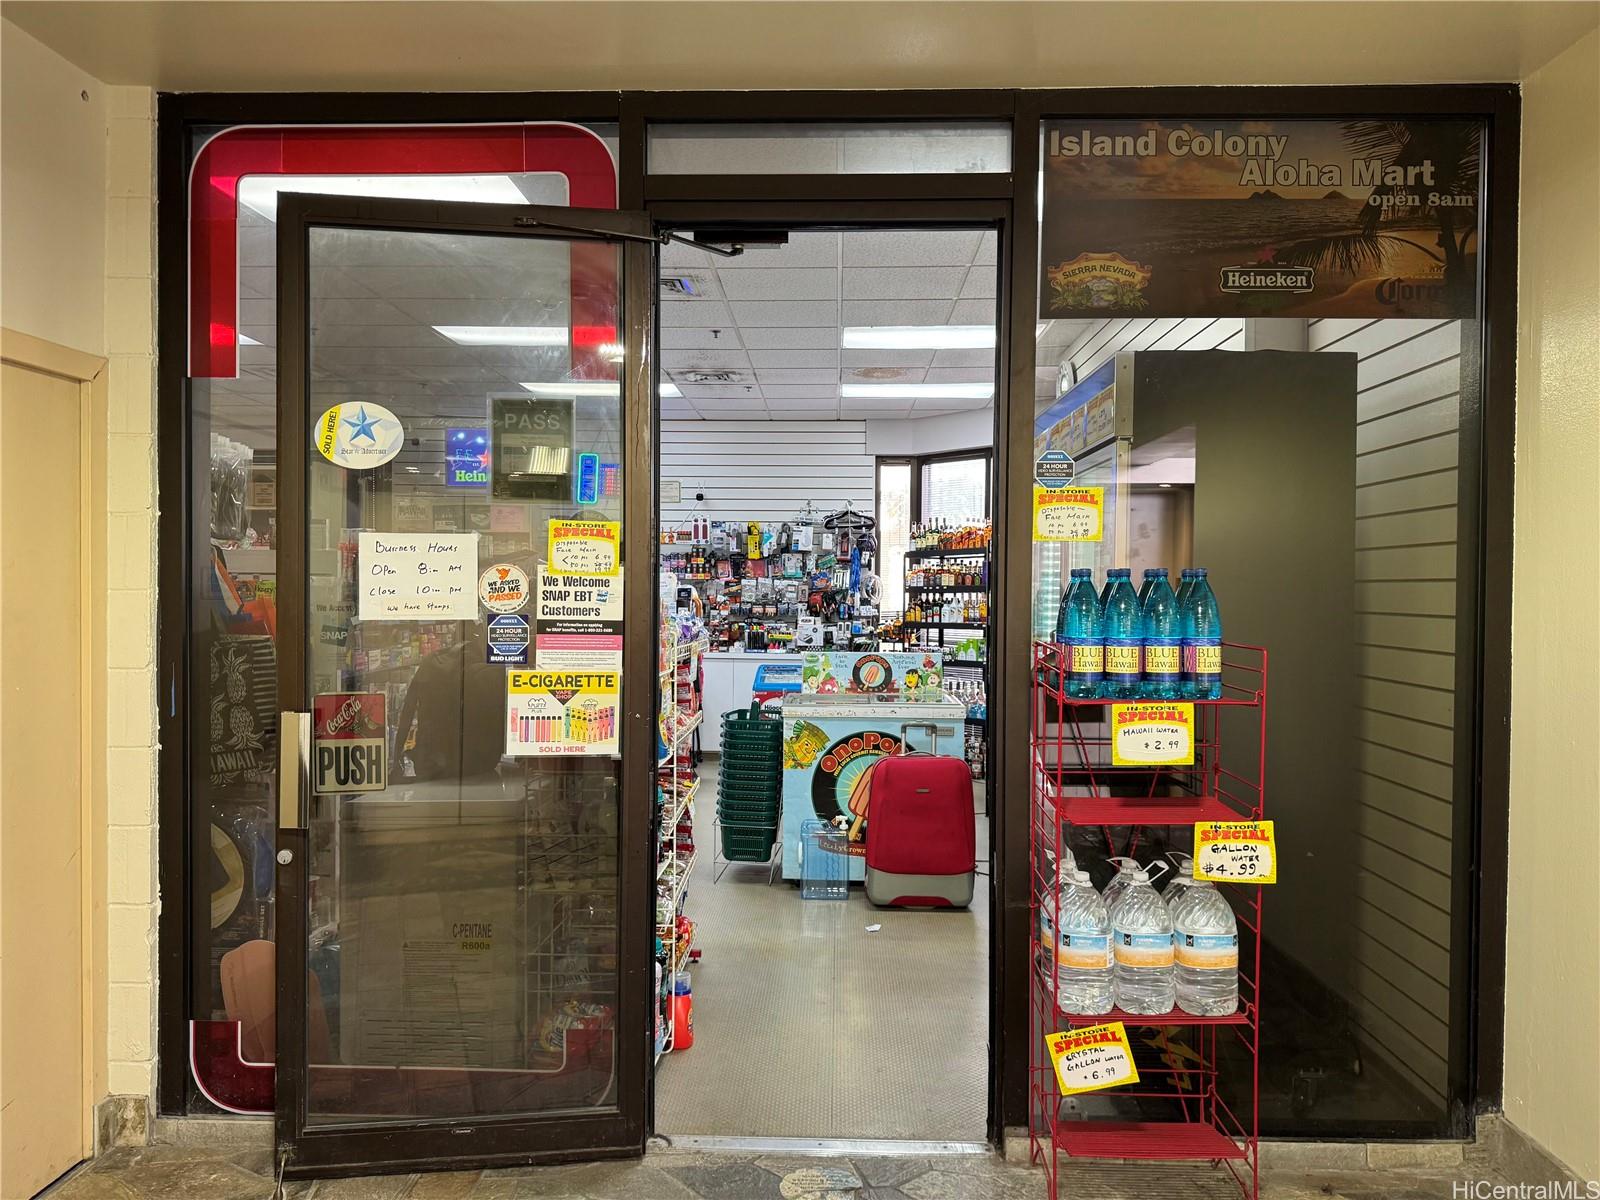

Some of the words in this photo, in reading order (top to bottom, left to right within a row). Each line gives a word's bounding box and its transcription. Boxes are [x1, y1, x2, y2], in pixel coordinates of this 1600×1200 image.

[1050, 129, 1156, 157] Island
[1168, 129, 1288, 161] Colony
[1238, 158, 1342, 187] Aloha
[1351, 159, 1436, 187] Mart
[1368, 193, 1423, 210] open
[1427, 191, 1475, 208] 8am
[1062, 264, 1098, 280] SIERRA
[1099, 264, 1137, 279] NEVADA
[1227, 271, 1308, 287] Heineken
[326, 410, 337, 434] HERE!
[504, 413, 561, 430] PASS
[322, 435, 333, 455] SOLD
[1038, 494, 1099, 505] SPECIAL
[553, 527, 615, 540] SPECIAL
[375, 541, 416, 553] Business
[427, 542, 458, 553] Hours
[542, 575, 559, 587] We
[562, 576, 611, 588] Welcome
[488, 586, 505, 594] AND
[508, 584, 520, 592] WE
[489, 592, 522, 602] PASSED
[541, 590, 571, 602] SNAP
[574, 590, 594, 602] EBT
[541, 604, 601, 617] Customers
[320, 631, 348, 640] SNAP
[1106, 648, 1138, 658] BLUE
[1146, 648, 1178, 658] BLUE
[1106, 657, 1138, 669] Hawaii
[1146, 657, 1178, 669] Hawaii
[512, 674, 614, 688] E-CIGARETTE
[1118, 710, 1188, 724] SPECIAL
[1123, 727, 1153, 736] HAWAII
[563, 745, 586, 753] HERE
[318, 744, 382, 786] PUSH
[1201, 829, 1270, 841] SPECIAL
[1211, 844, 1258, 854] GALLON
[1203, 862, 1257, 877] $4.99
[452, 923, 492, 938] C-PENTANE
[461, 941, 490, 950] R600a
[1060, 1026, 1109, 1040] IN-STORE
[1053, 1030, 1122, 1054] SPECIAL
[1065, 1047, 1105, 1061] CRYSTAL
[1067, 1058, 1101, 1072] GALLON
